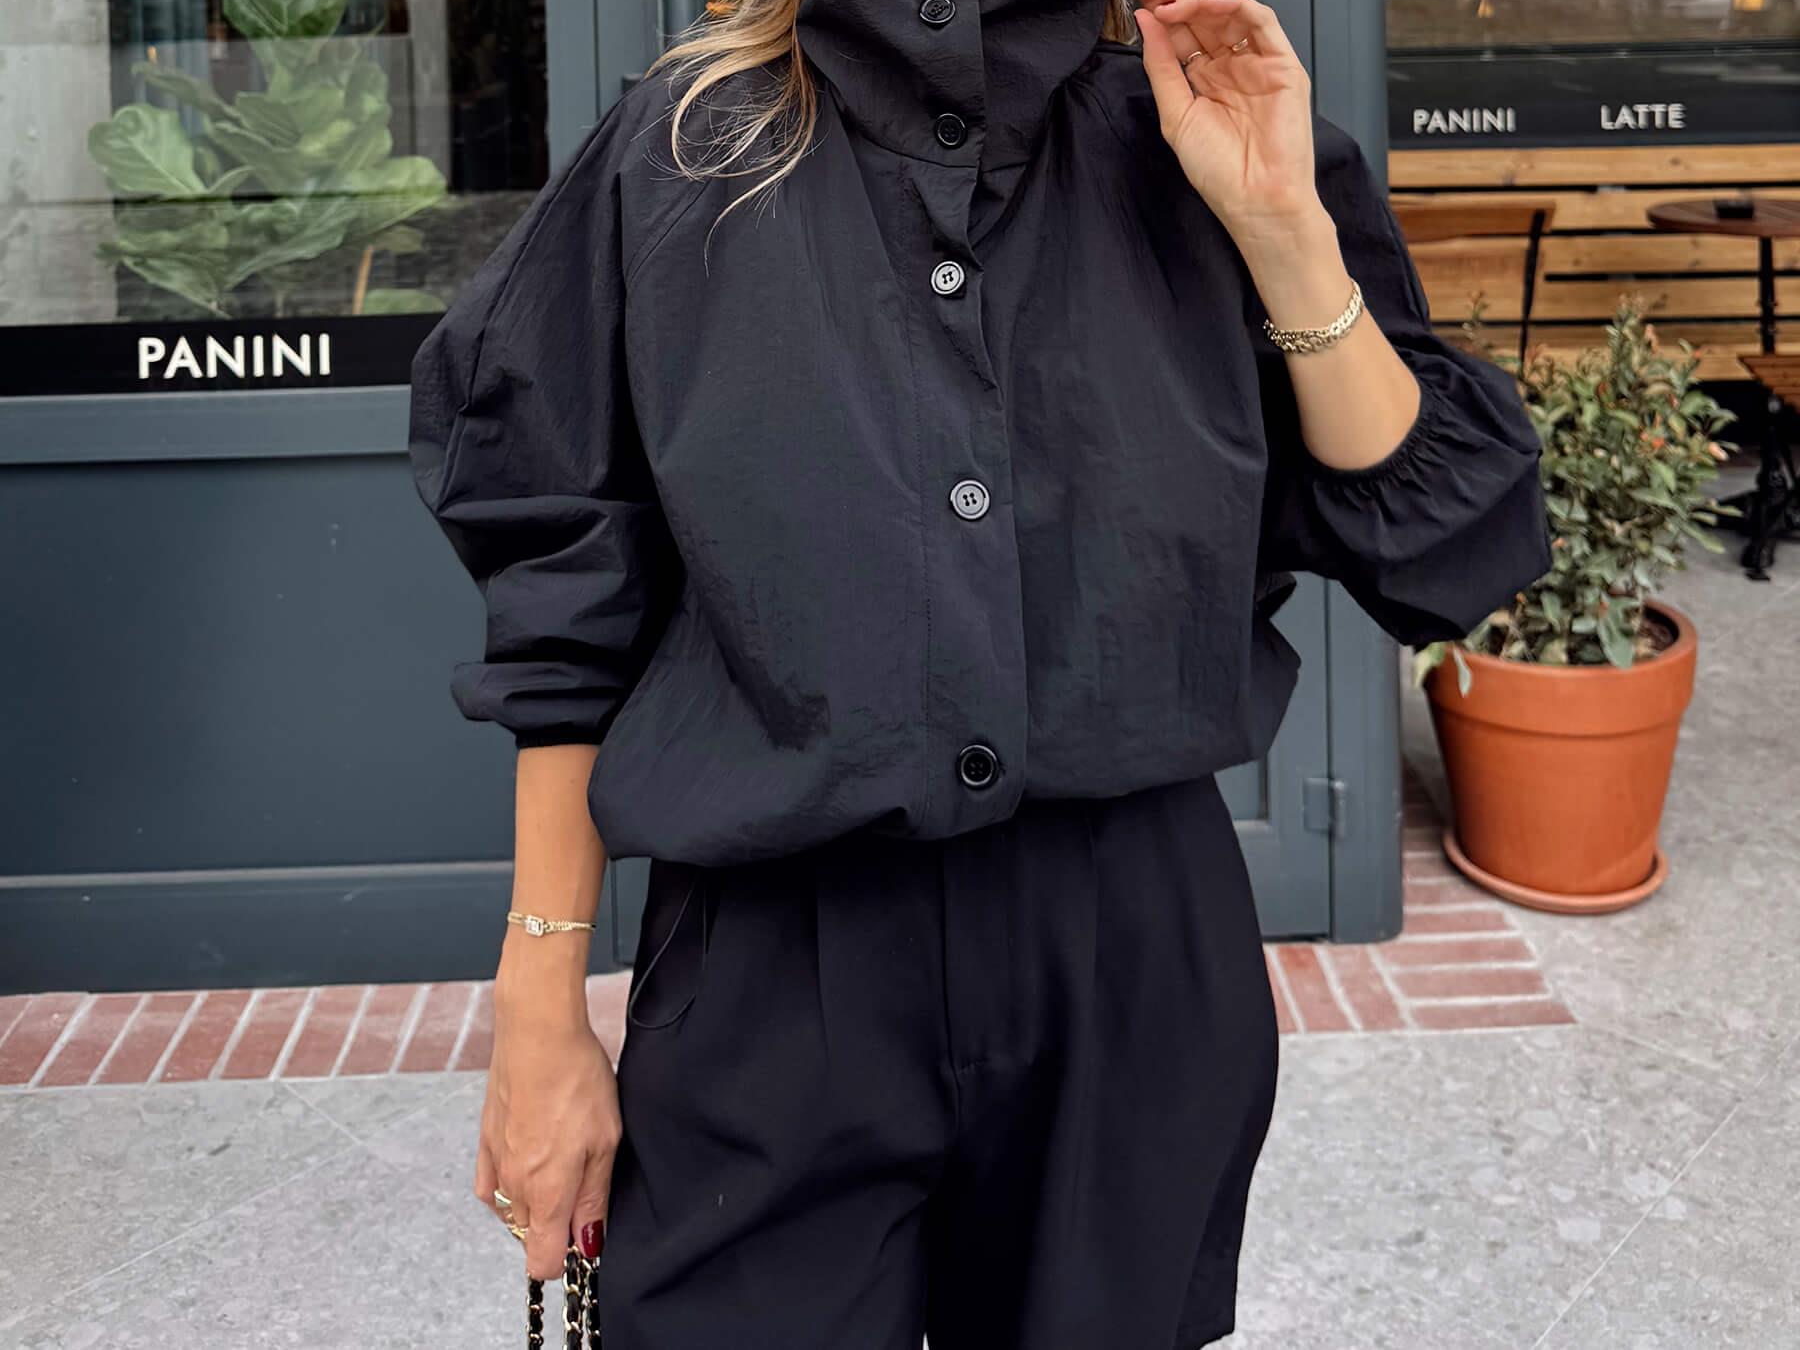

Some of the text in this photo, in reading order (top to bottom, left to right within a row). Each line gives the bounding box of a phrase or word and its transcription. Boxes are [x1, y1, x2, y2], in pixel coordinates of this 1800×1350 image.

[1413, 103, 1686, 134] PANINI LATTE
[138, 333, 331, 379] PANINI
